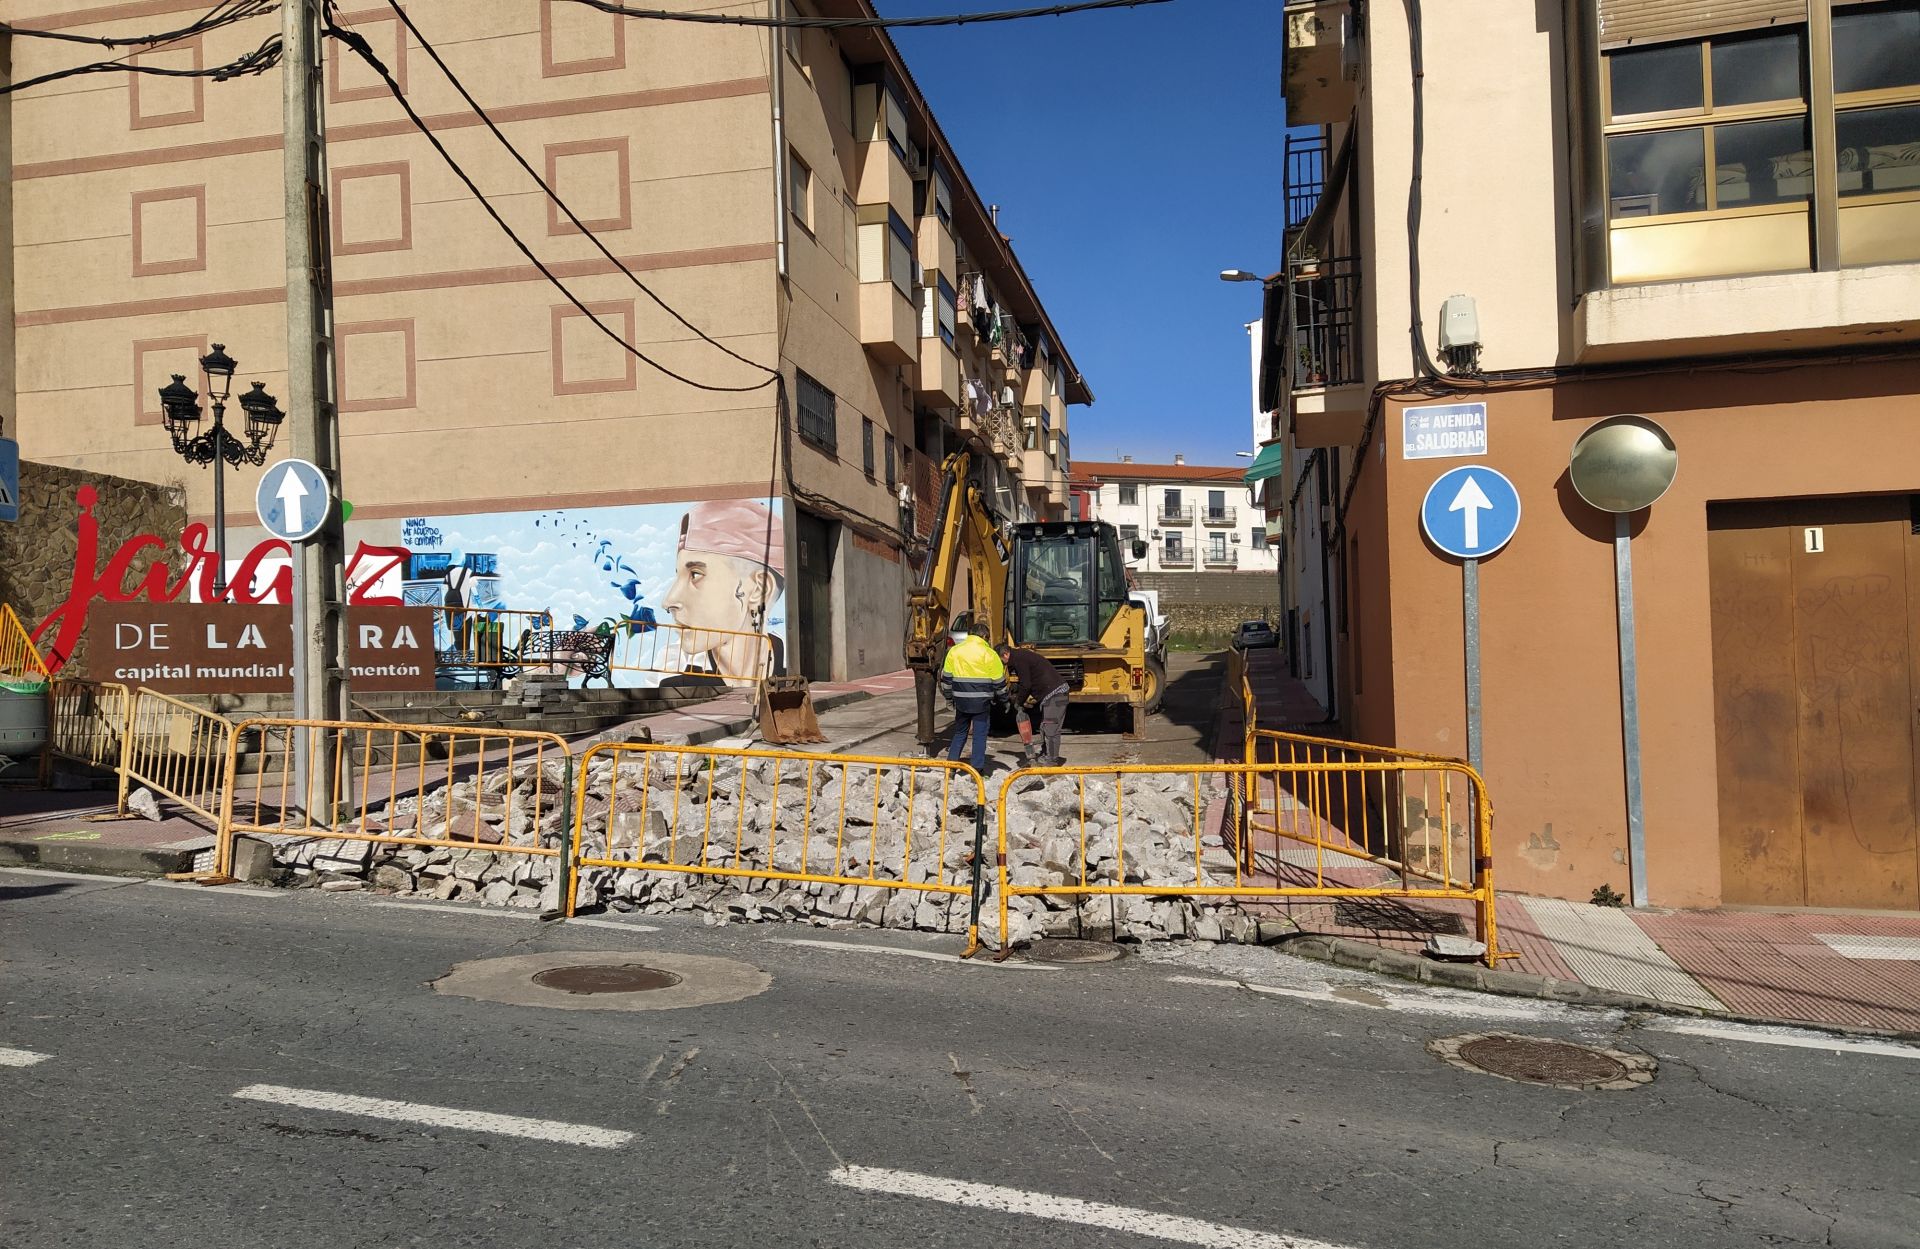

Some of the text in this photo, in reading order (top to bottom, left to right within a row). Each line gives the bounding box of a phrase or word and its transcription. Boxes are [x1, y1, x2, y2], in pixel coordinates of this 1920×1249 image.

[1433, 413, 1482, 428] AVENIDA
[1416, 430, 1485, 450] SALOBRAR
[1809, 529, 1819, 551] 1
[115, 623, 170, 650] DE
[207, 623, 267, 649] LA
[115, 663, 190, 682] capital
[196, 663, 283, 678] mundial
[350, 662, 420, 677] mentón
